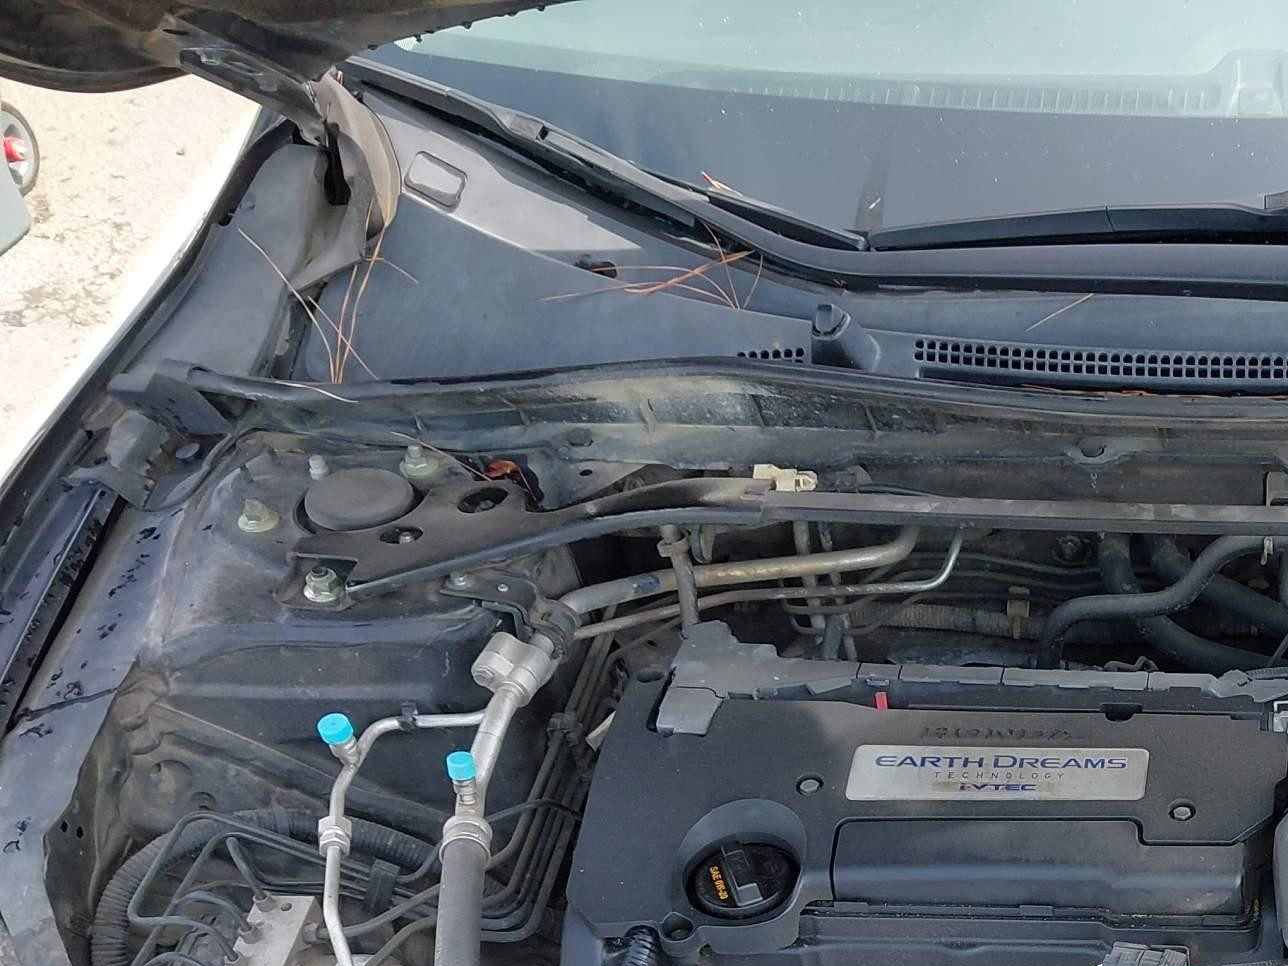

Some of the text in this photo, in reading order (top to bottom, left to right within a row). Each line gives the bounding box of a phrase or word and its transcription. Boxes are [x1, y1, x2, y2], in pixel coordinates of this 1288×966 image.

[875, 754, 1128, 769] EARTH DREAMS
[934, 771, 1065, 780] TECHNOLOGY
[959, 782, 1037, 792] i-VTEC
[709, 866, 722, 881] SAE
